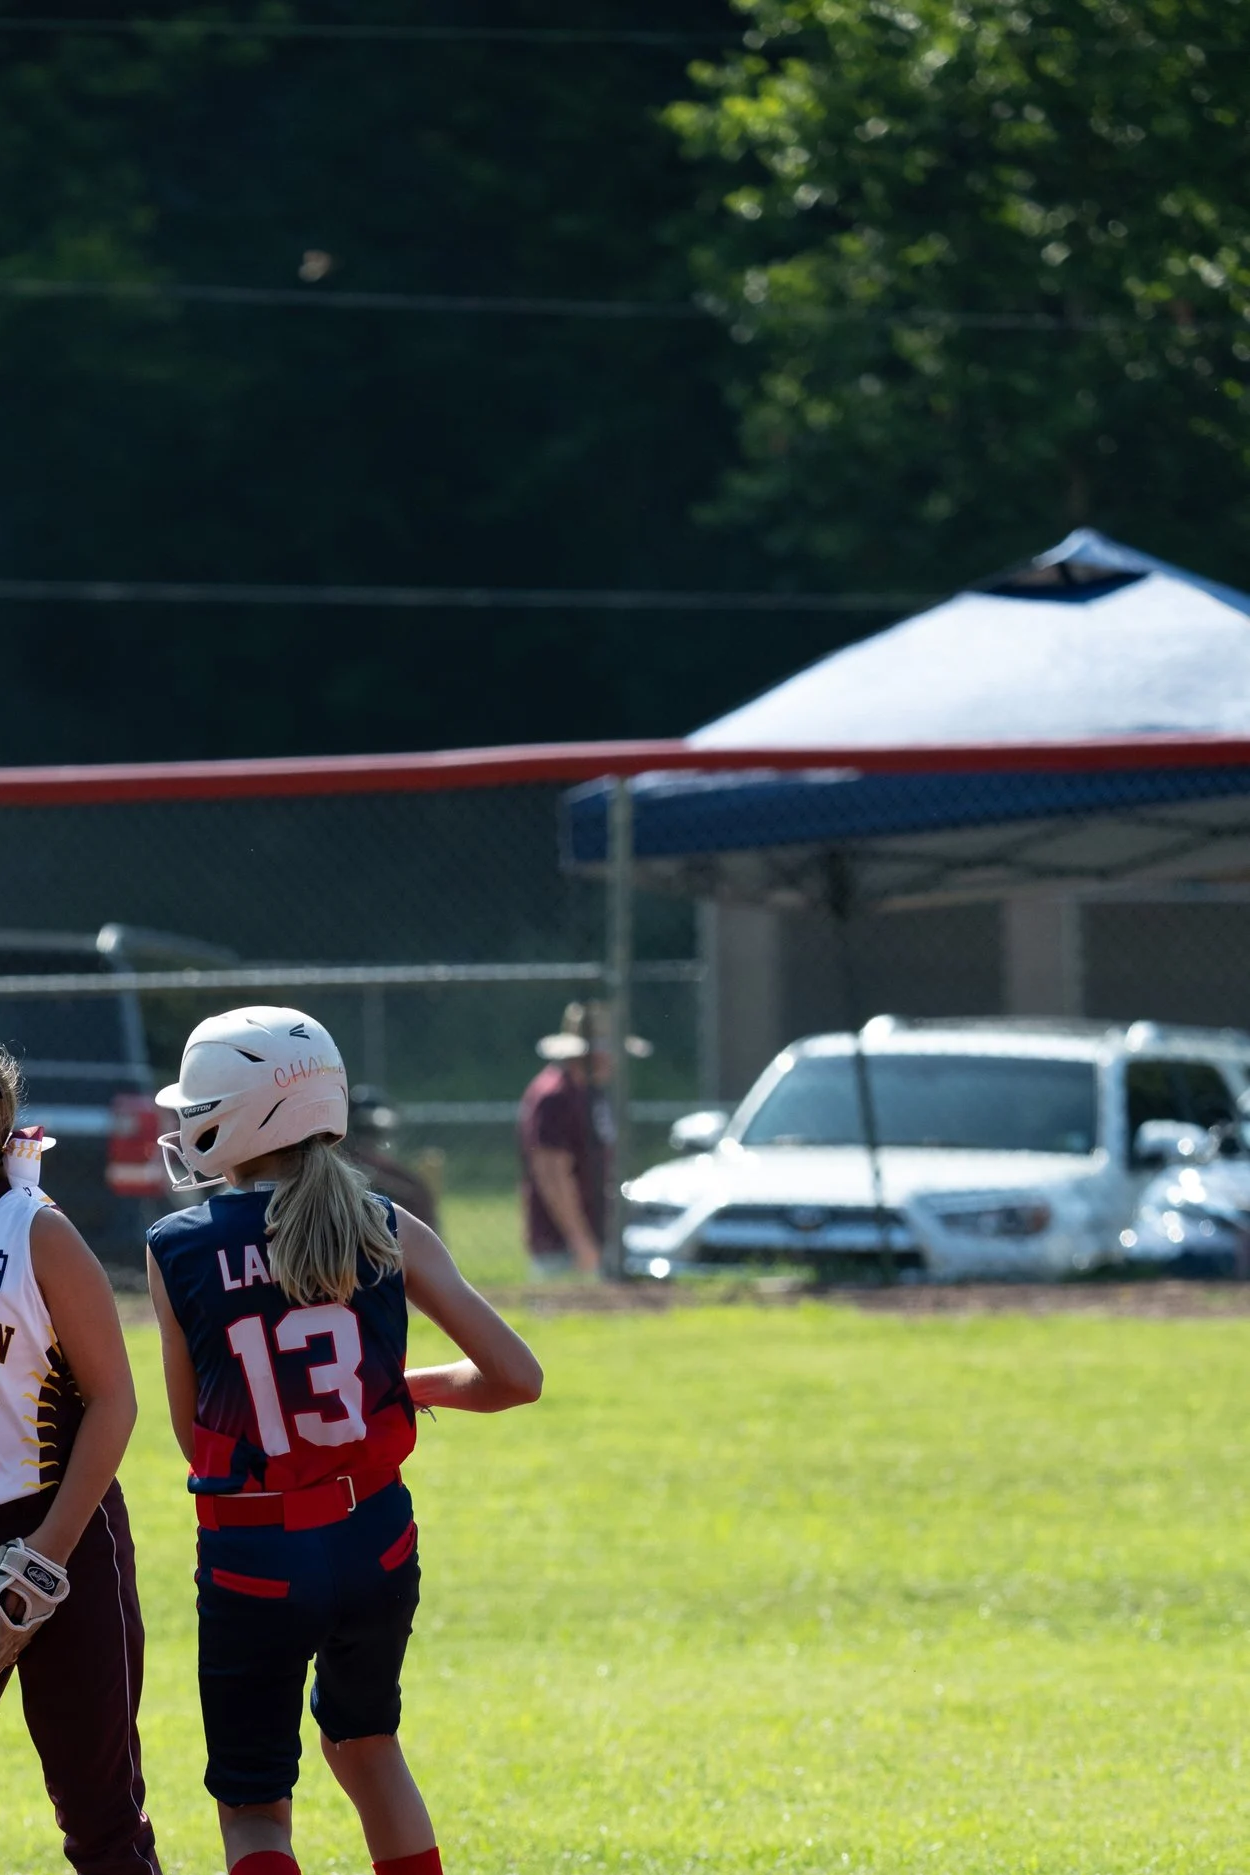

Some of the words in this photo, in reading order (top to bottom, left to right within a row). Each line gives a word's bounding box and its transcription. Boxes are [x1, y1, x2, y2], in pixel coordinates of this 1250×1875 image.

[183, 1103, 212, 1114] EASTON
[216, 1244, 281, 1292] LA
[225, 1301, 368, 1458] 13
